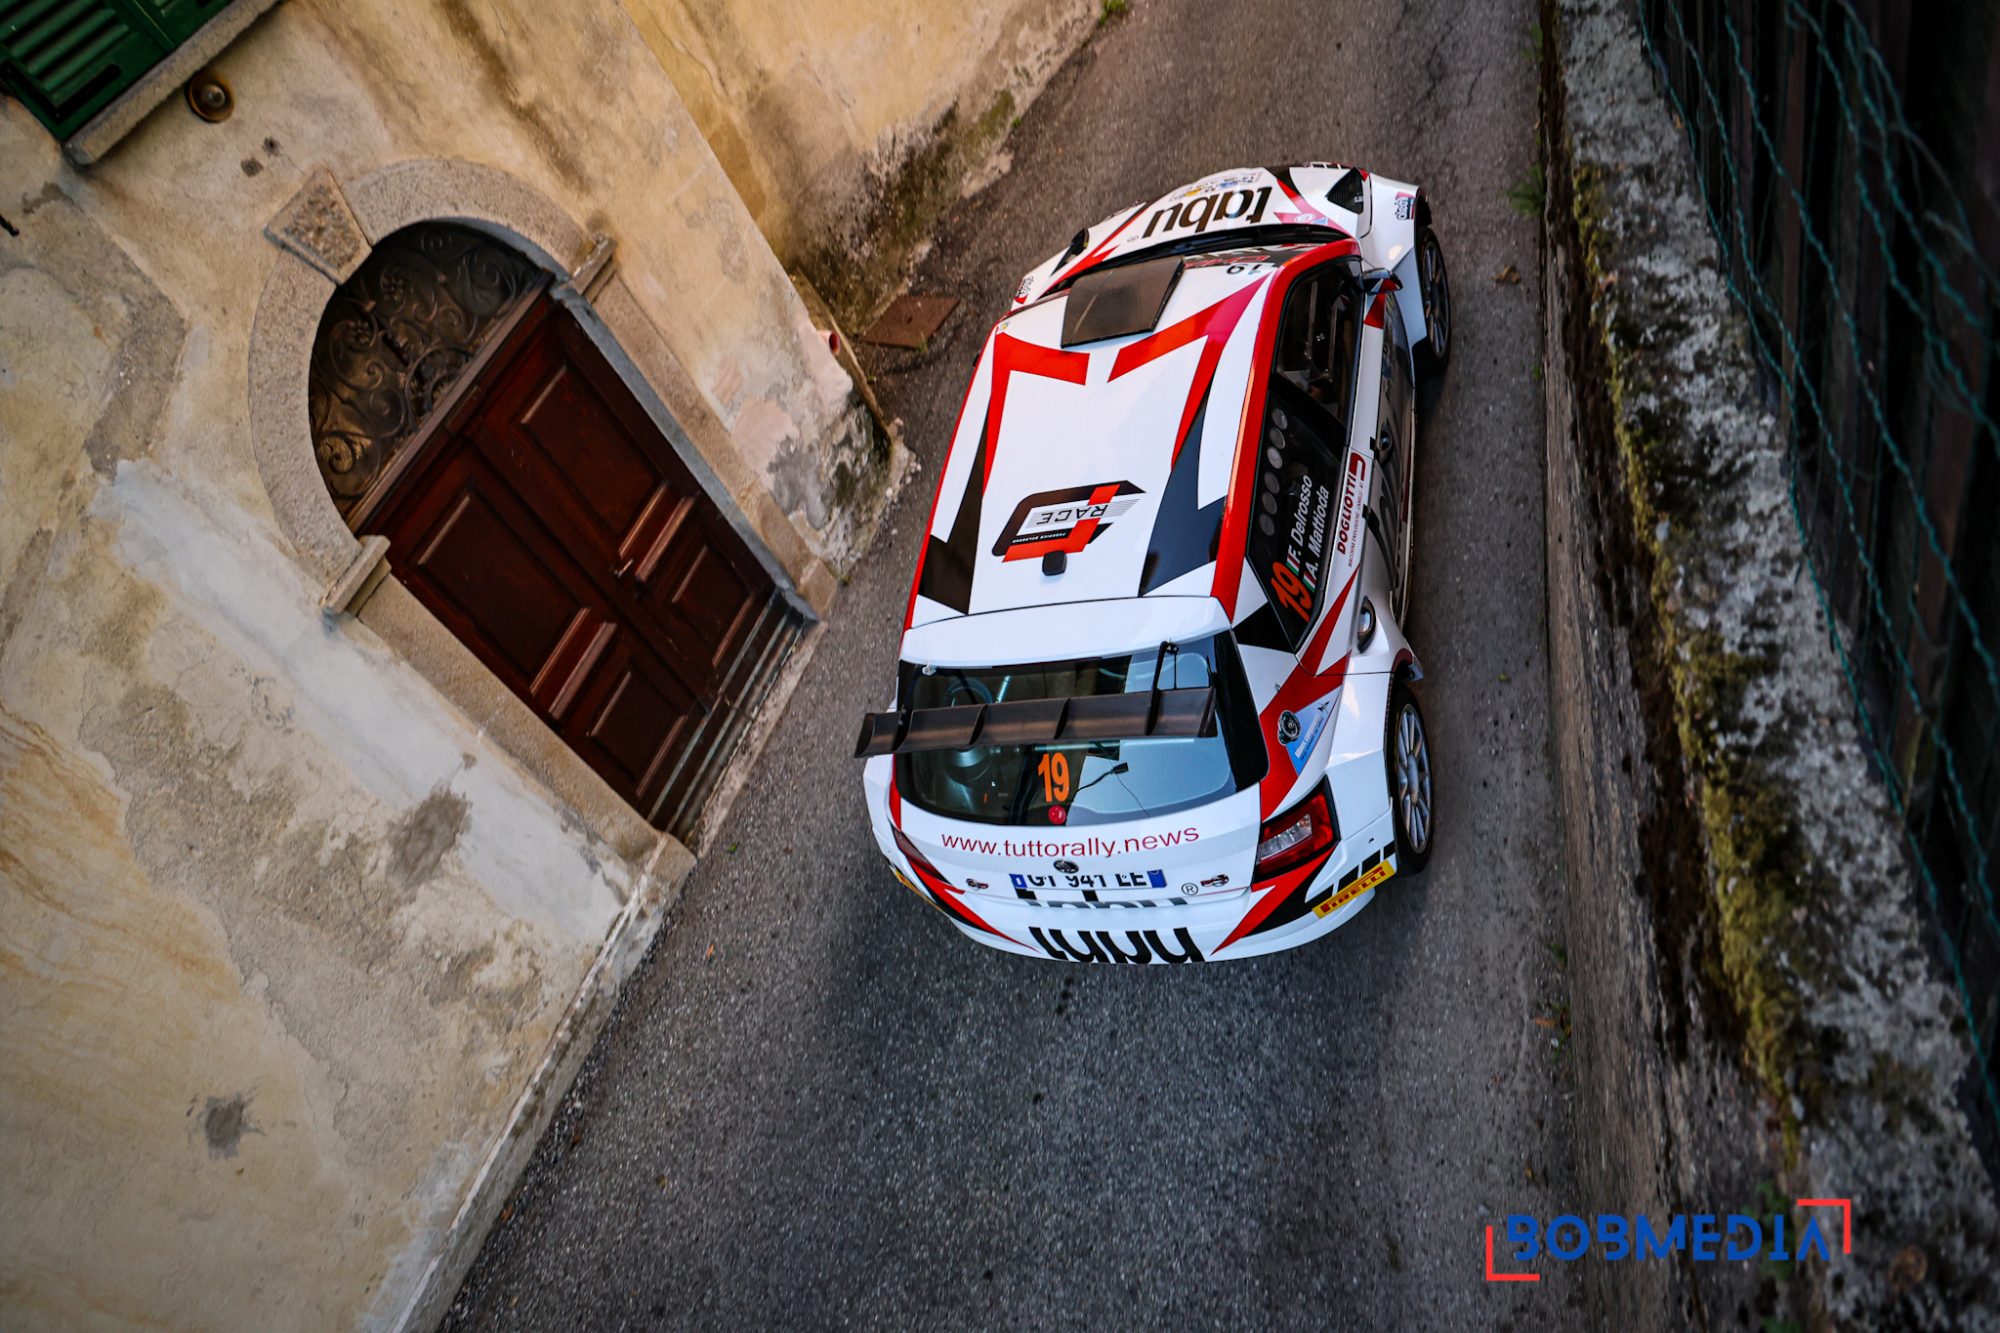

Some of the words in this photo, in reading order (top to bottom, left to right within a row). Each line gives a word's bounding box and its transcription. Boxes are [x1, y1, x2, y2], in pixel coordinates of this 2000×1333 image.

[1142, 187, 1273, 239] tabu
[1226, 264, 1262, 275] 19
[1037, 504, 1108, 525] RACE
[1291, 475, 1312, 546] Delrosso
[1308, 485, 1330, 558] Mattioda
[1337, 474, 1357, 555] DOGLIOTTI
[1287, 545, 1301, 564] F.
[1305, 561, 1319, 580] A.
[1271, 561, 1312, 623] 19
[1038, 752, 1070, 802] 19
[942, 827, 1199, 858] www.tuttorally.news
